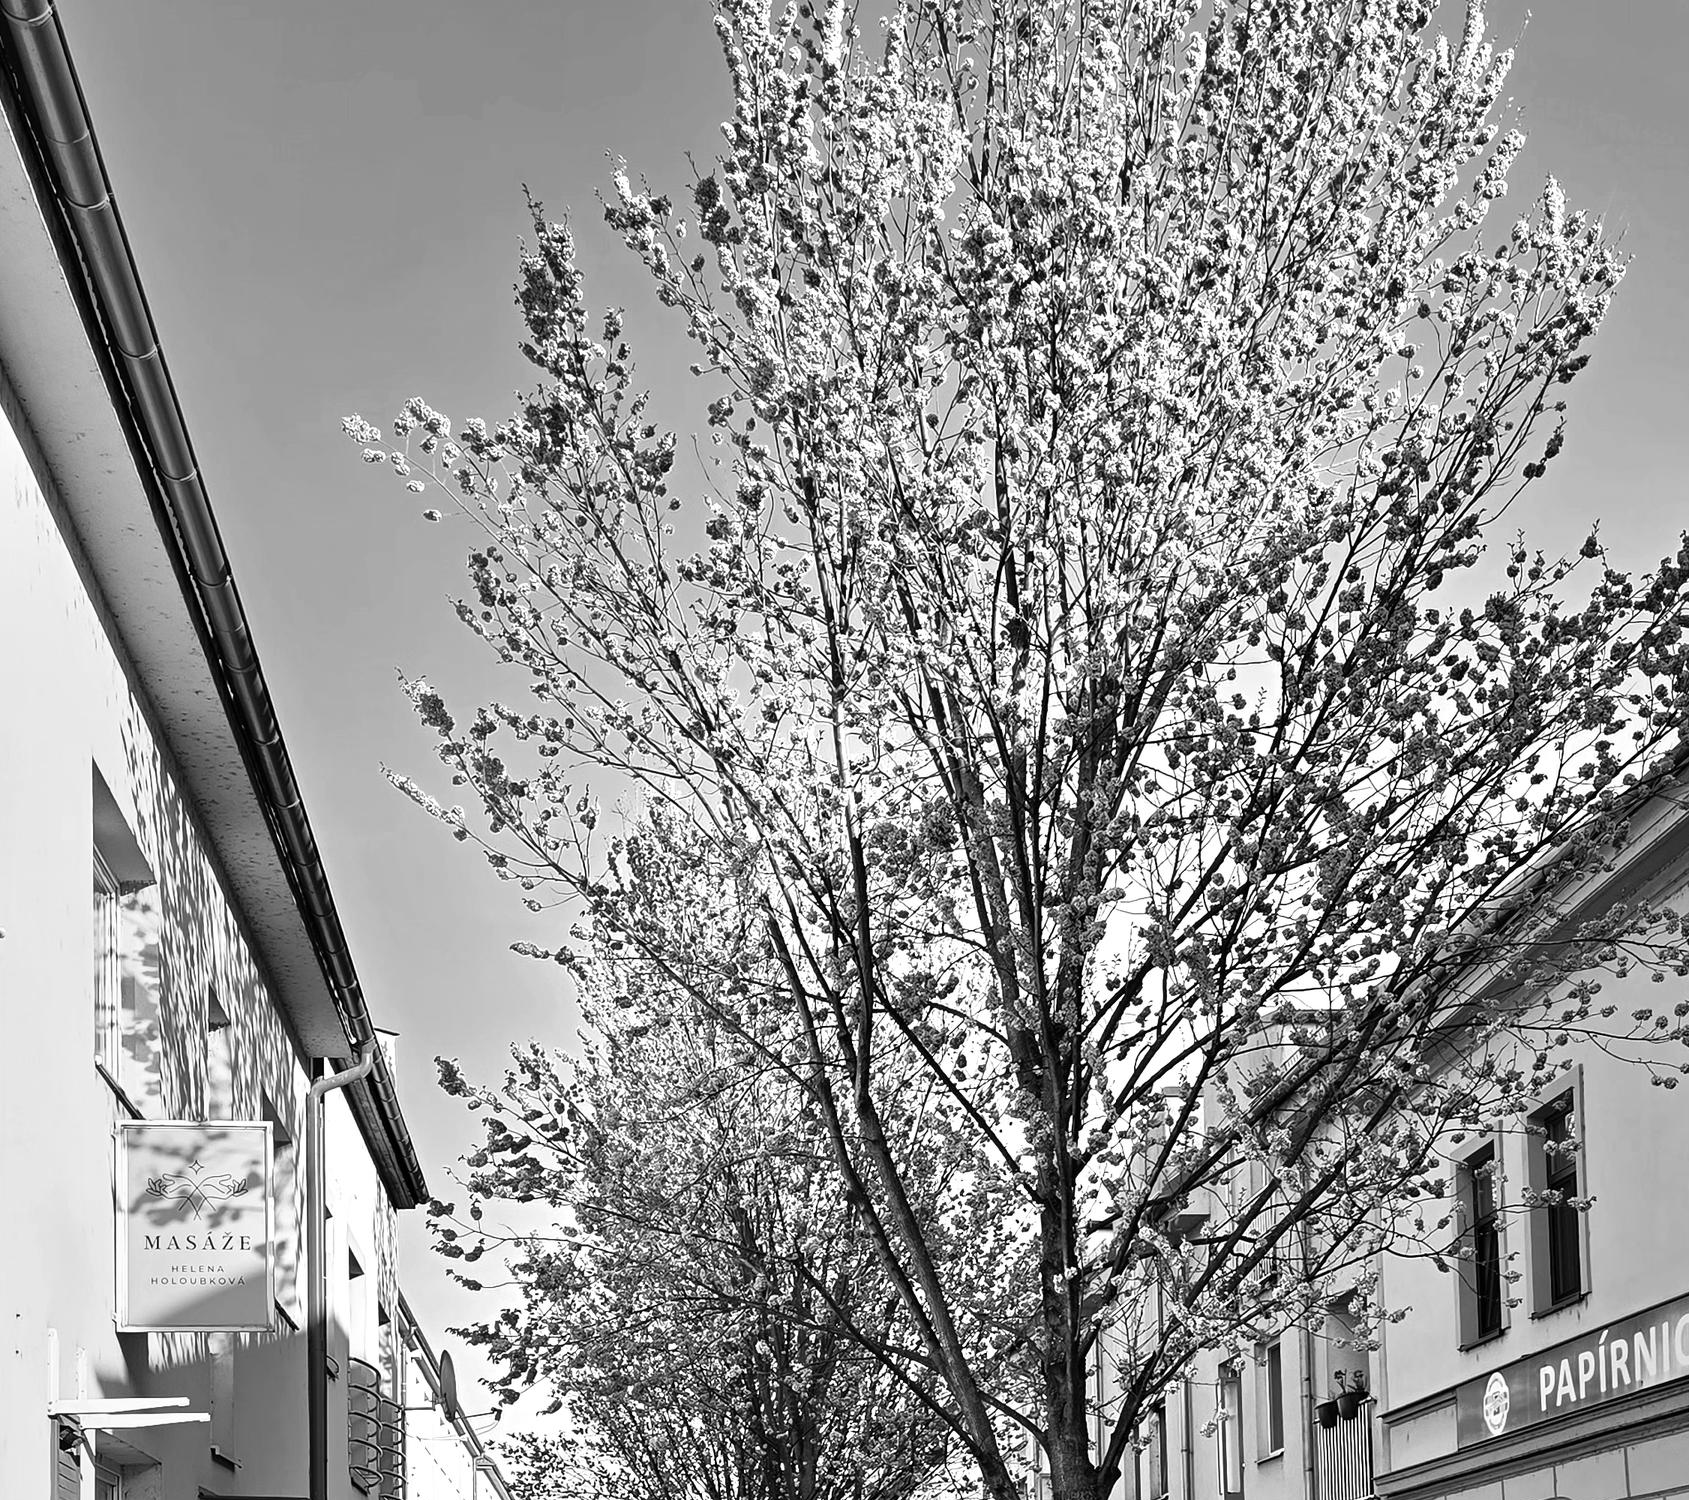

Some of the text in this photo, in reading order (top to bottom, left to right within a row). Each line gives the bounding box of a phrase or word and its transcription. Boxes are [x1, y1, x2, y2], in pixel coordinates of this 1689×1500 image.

[144, 1231, 252, 1251] MASÁŽE
[171, 1265, 225, 1273] HELENA
[151, 1275, 246, 1286] HOLOUBKOVÁ
